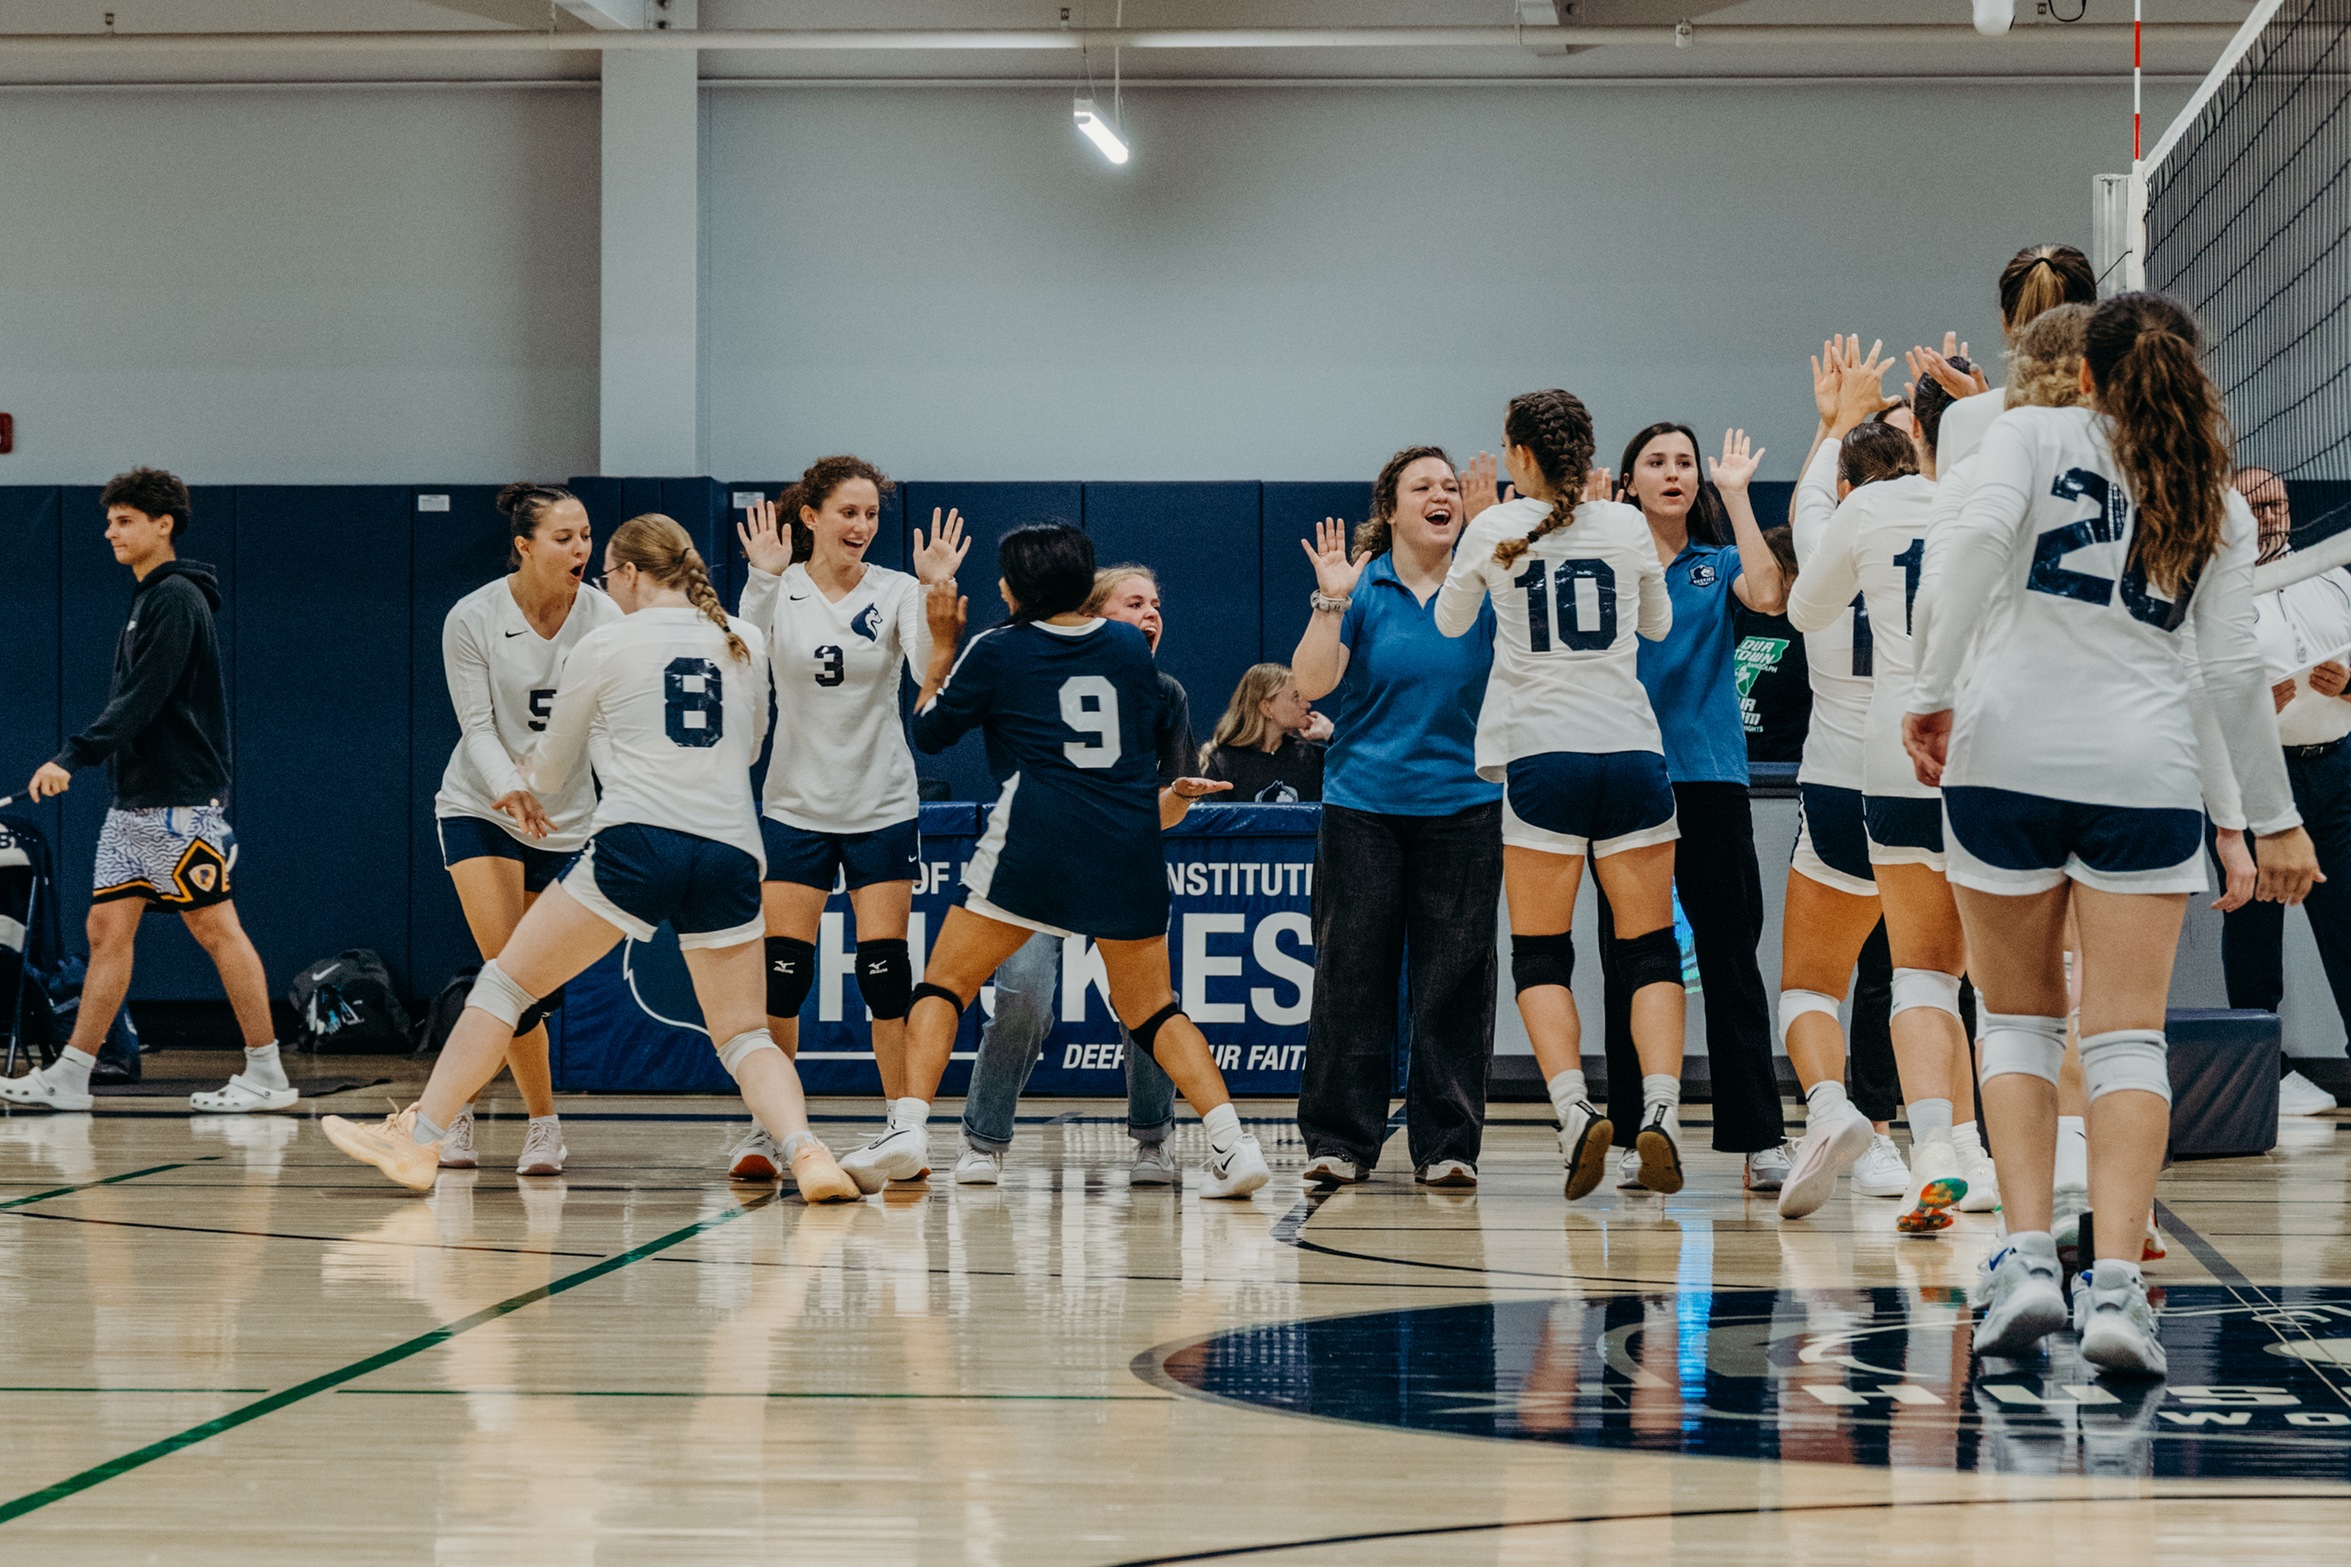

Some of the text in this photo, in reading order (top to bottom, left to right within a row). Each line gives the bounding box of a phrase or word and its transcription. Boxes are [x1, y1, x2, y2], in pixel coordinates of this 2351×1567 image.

[1514, 558, 1617, 652] 10
[814, 645, 844, 687] 3
[1735, 649, 1775, 664] TOWN
[528, 689, 557, 731] 5
[664, 657, 723, 747] 8
[1058, 675, 1121, 768] 9
[1247, 1045, 1307, 1071] FAIT
[1801, 1385, 2351, 1405] HUS
